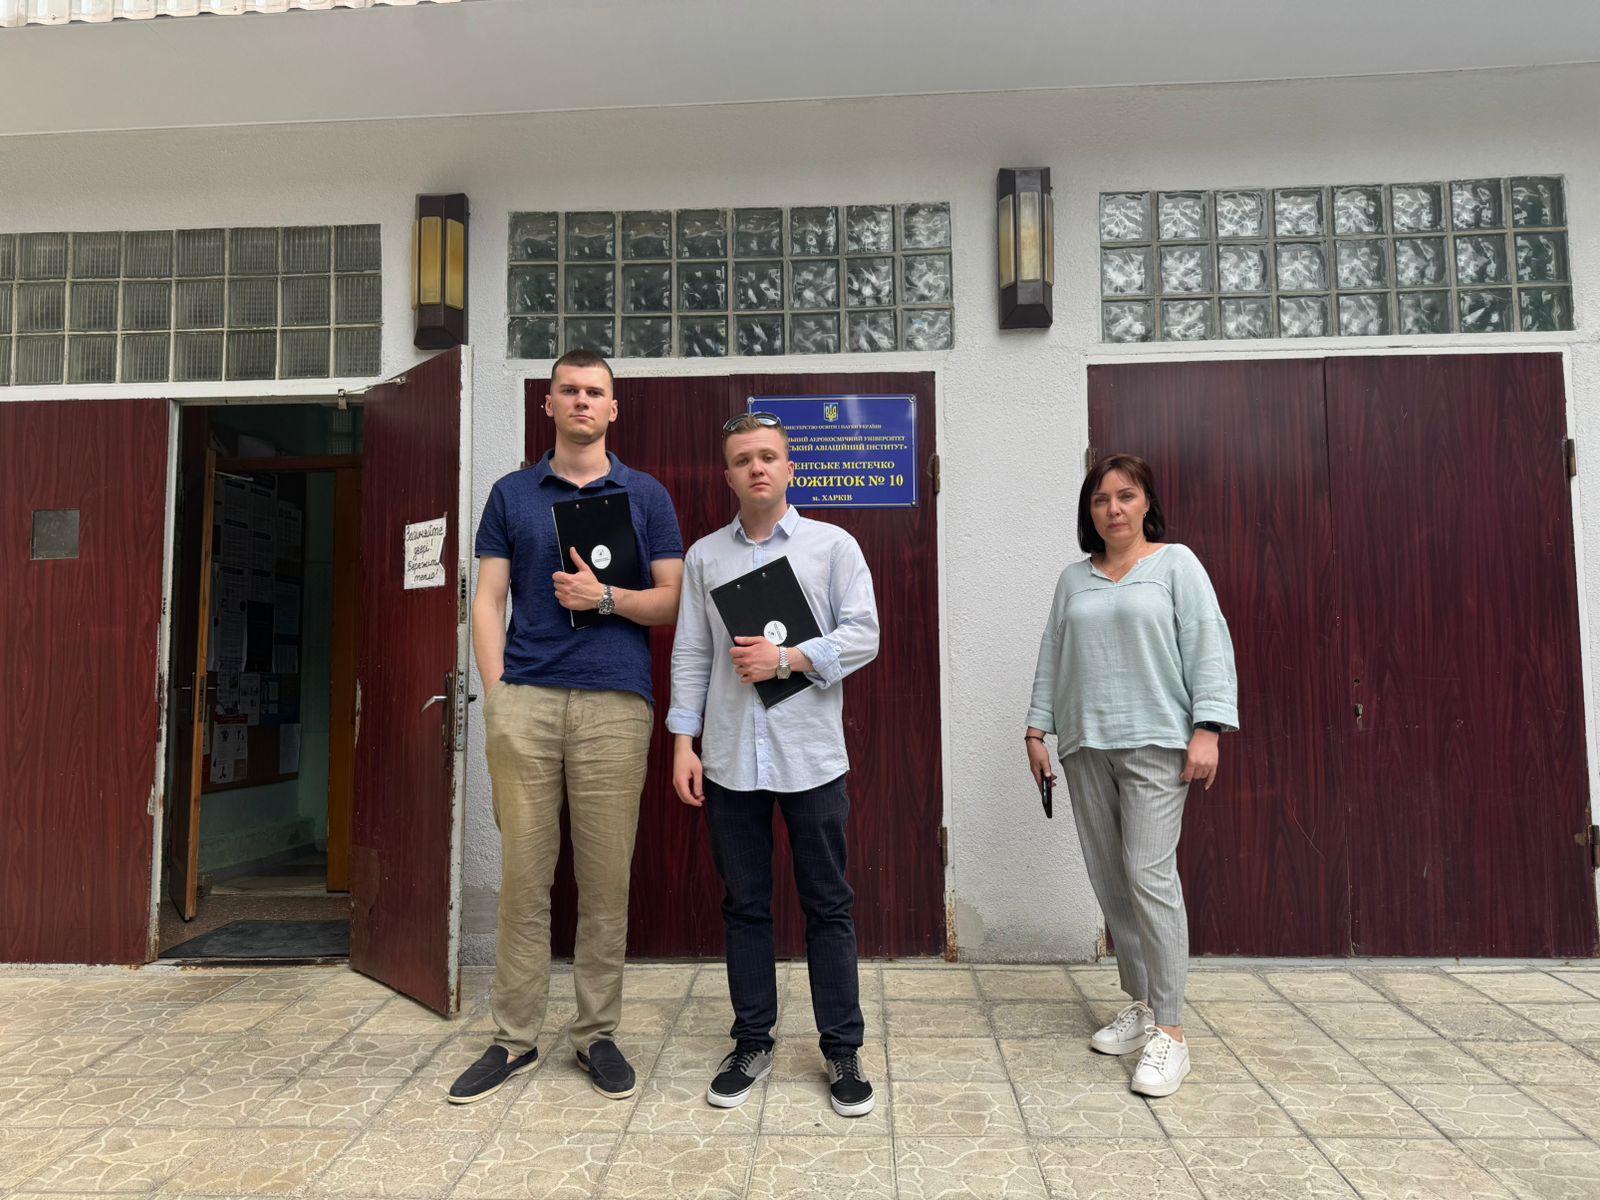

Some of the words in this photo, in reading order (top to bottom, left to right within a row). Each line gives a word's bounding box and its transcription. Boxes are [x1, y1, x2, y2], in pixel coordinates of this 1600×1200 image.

[815, 443, 865, 452] АВІАЦІЙНИЙ
[795, 462, 840, 470] ЕНТСЬКЕ
[842, 461, 895, 469] МІСТЕЧКО
[789, 475, 865, 488] ТОЖИТОК
[868, 475, 885, 486] №
[890, 474, 904, 486] 10
